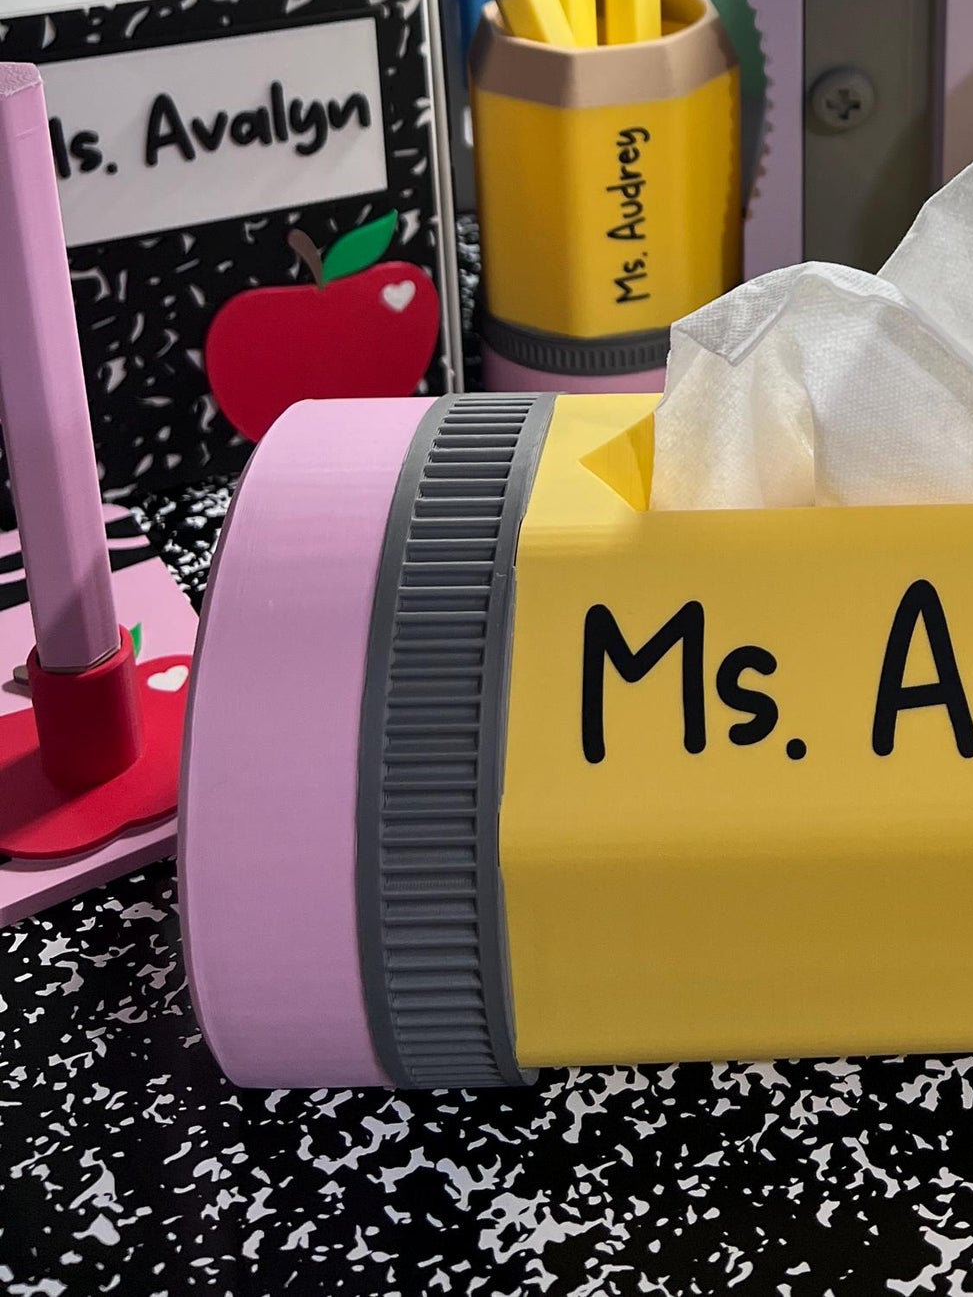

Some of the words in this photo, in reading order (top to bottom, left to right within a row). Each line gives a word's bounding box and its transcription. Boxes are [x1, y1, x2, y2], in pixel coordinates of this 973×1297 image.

[145, 80, 372, 166] Avalyn
[606, 126, 651, 241] Audrey
[613, 251, 652, 304] Ms.
[582, 599, 808, 765] Ms.
